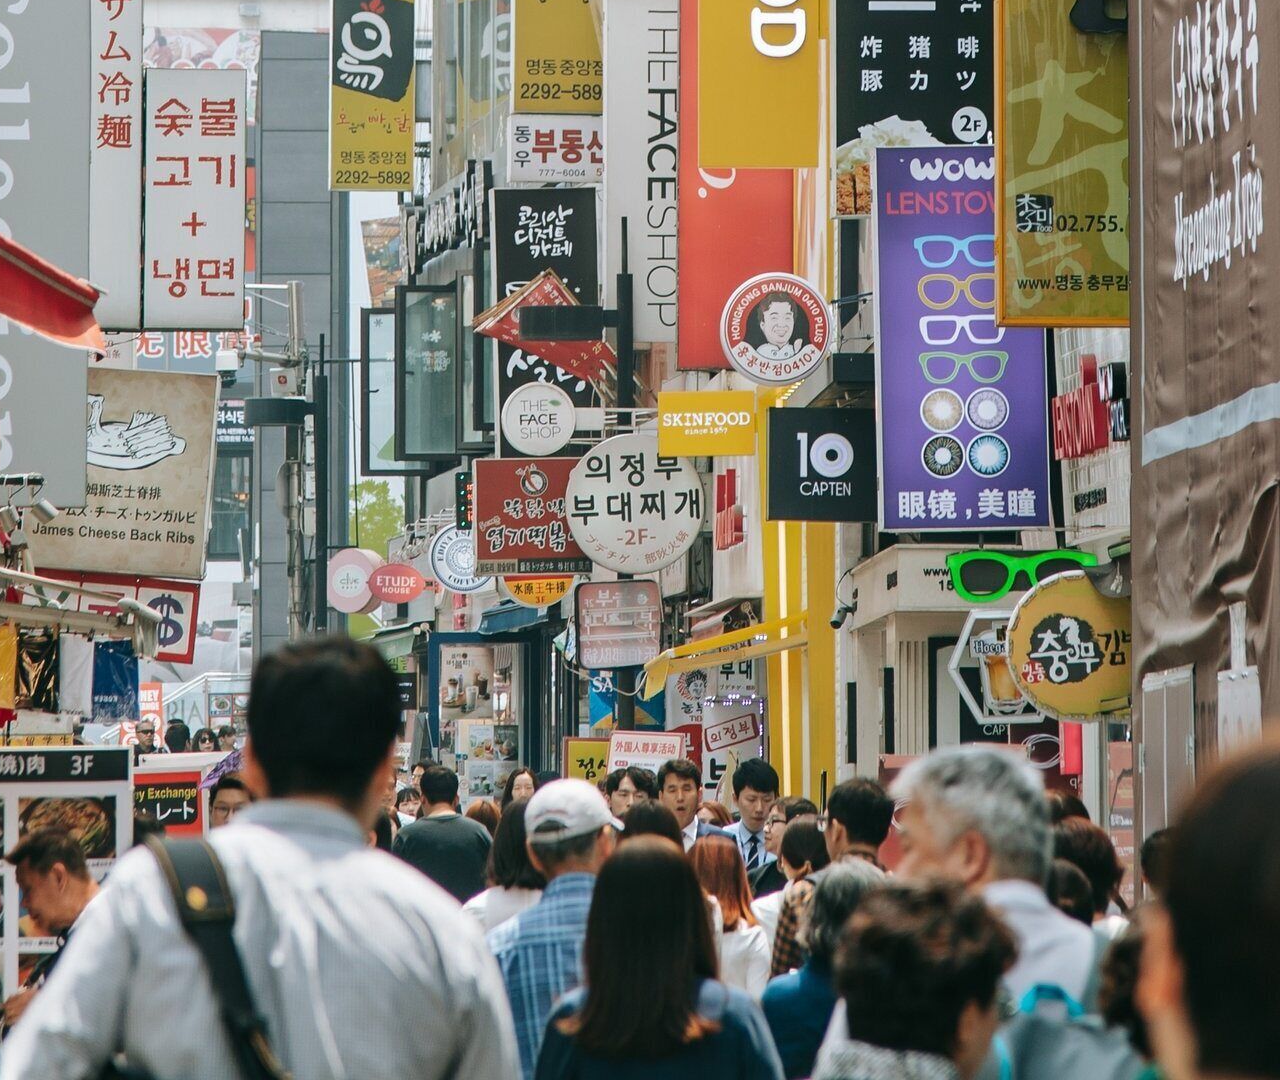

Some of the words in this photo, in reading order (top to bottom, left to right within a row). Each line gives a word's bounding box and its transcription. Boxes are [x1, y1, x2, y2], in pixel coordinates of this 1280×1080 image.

[526, 59, 557, 76] 명동
[860, 70, 977, 92] 豚カツ
[521, 83, 603, 100] 2292-589
[154, 97, 238, 137] 숯불
[960, 115, 982, 132] 2F
[340, 151, 365, 165] 명동
[368, 151, 407, 165] 중앙점
[152, 154, 236, 188] 고기
[335, 170, 411, 184] 2292-5892
[910, 157, 995, 182] WOW
[518, 204, 574, 228] 코리안
[529, 240, 573, 259] 카페
[152, 257, 235, 298] 냉면
[1087, 274, 1129, 291] 충무김
[731, 289, 761, 341] HONGKONG
[761, 282, 803, 300] BANJUM
[801, 294, 820, 316] 0410
[814, 316, 825, 344] PLUS
[520, 399, 549, 413] THE
[519, 414, 558, 427] FACE
[663, 411, 751, 427] SKINFOOD
[520, 426, 561, 440] SHOP
[584, 452, 682, 487] 의정부
[86, 484, 161, 500] 姆斯芝士脊排
[799, 481, 852, 497] CAPTEN
[570, 488, 701, 526] 부대찌개
[898, 488, 1036, 520] 眼镜,美瞳
[32, 522, 74, 538] James
[78, 525, 126, 541] Cheese
[130, 527, 162, 543] Back
[166, 528, 196, 545] Ribs
[486, 521, 571, 554] 엽기떡볶
[376, 575, 417, 588] ETUDE
[939, 579, 954, 591] 15
[382, 586, 411, 595] HOUSE
[592, 677, 613, 693] SA
[710, 720, 751, 744] 의정부
[983, 724, 1011, 736] CAPT
[71, 754, 94, 777] 3F
[147, 786, 198, 801] Exchange
